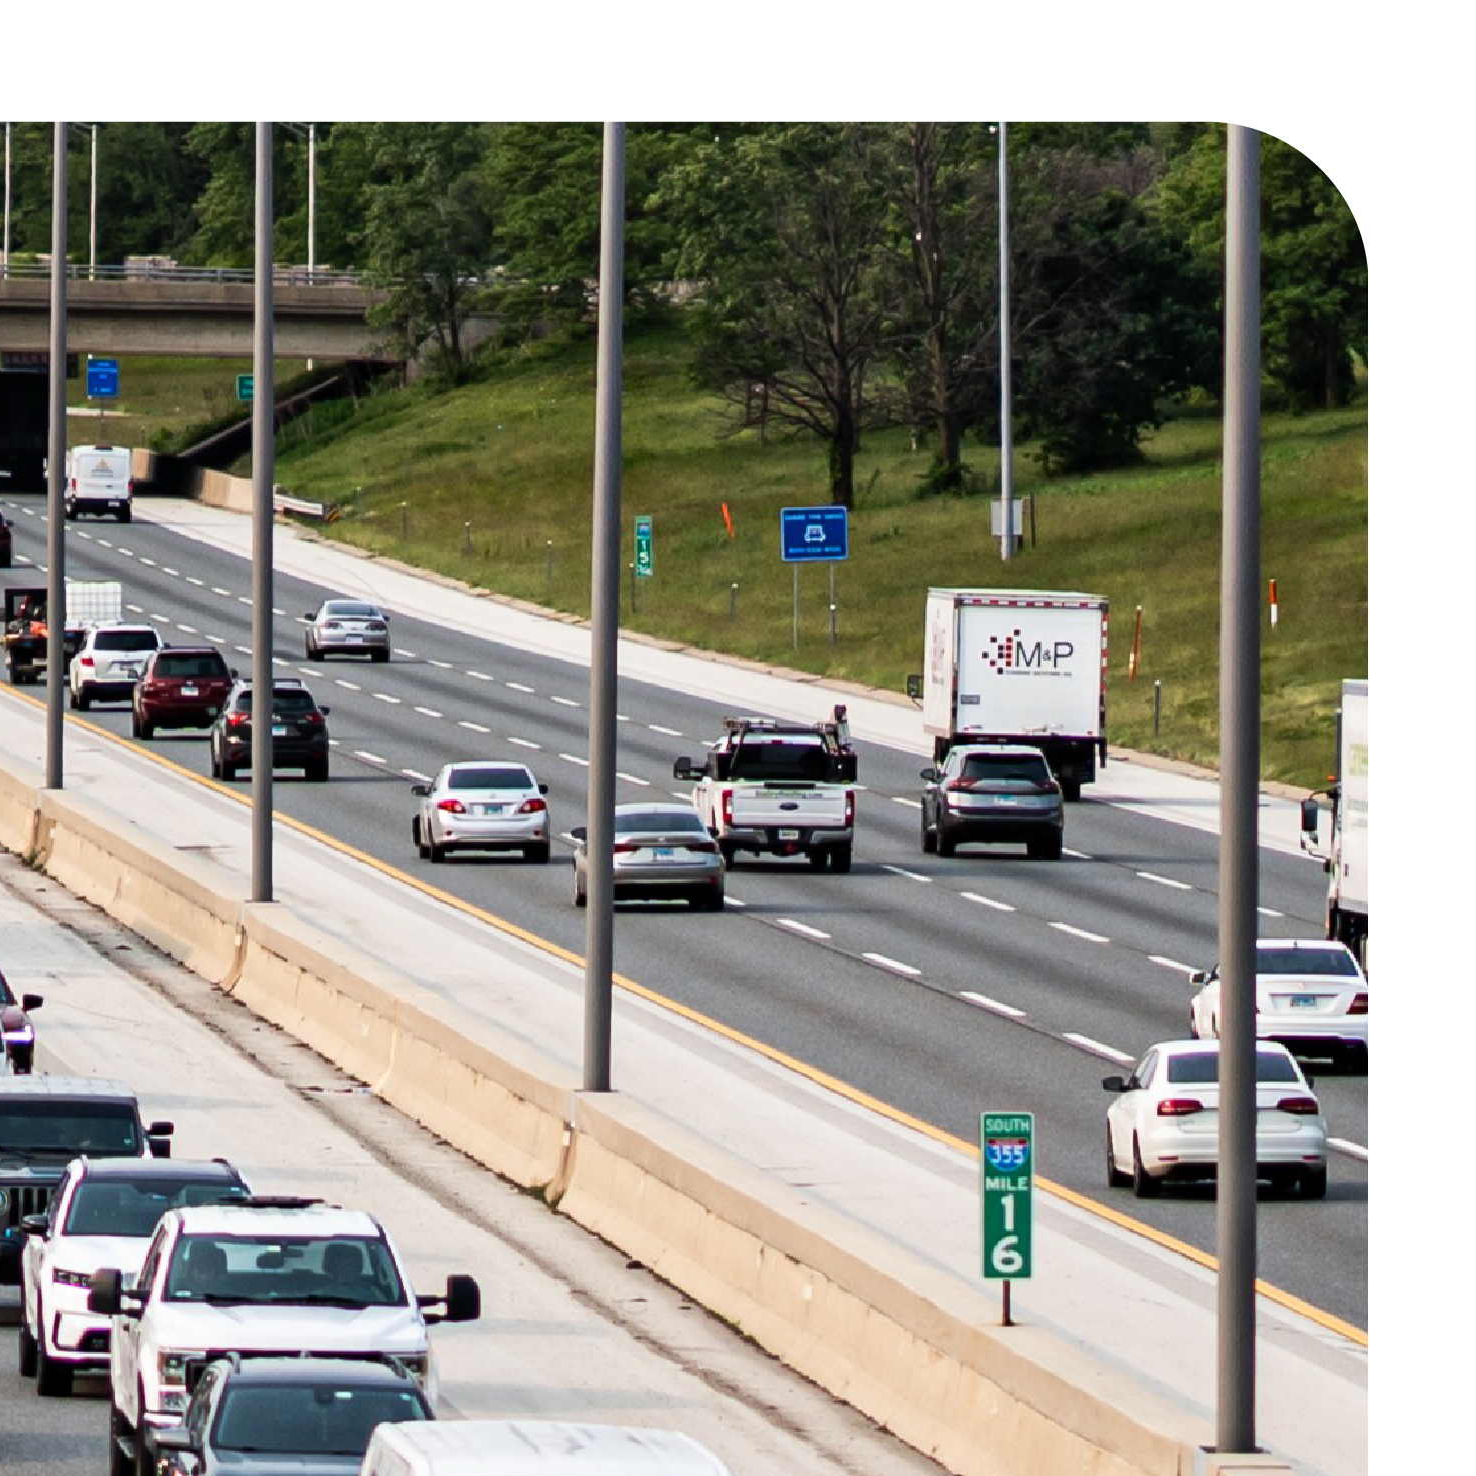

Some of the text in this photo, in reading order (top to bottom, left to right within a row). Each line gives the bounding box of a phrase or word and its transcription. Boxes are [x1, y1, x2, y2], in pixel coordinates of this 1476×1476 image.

[1015, 641, 1074, 668] M&P
[985, 1118, 1031, 1132] SOUTH
[992, 1146, 1025, 1164] 355
[985, 1175, 1028, 1191] MILE
